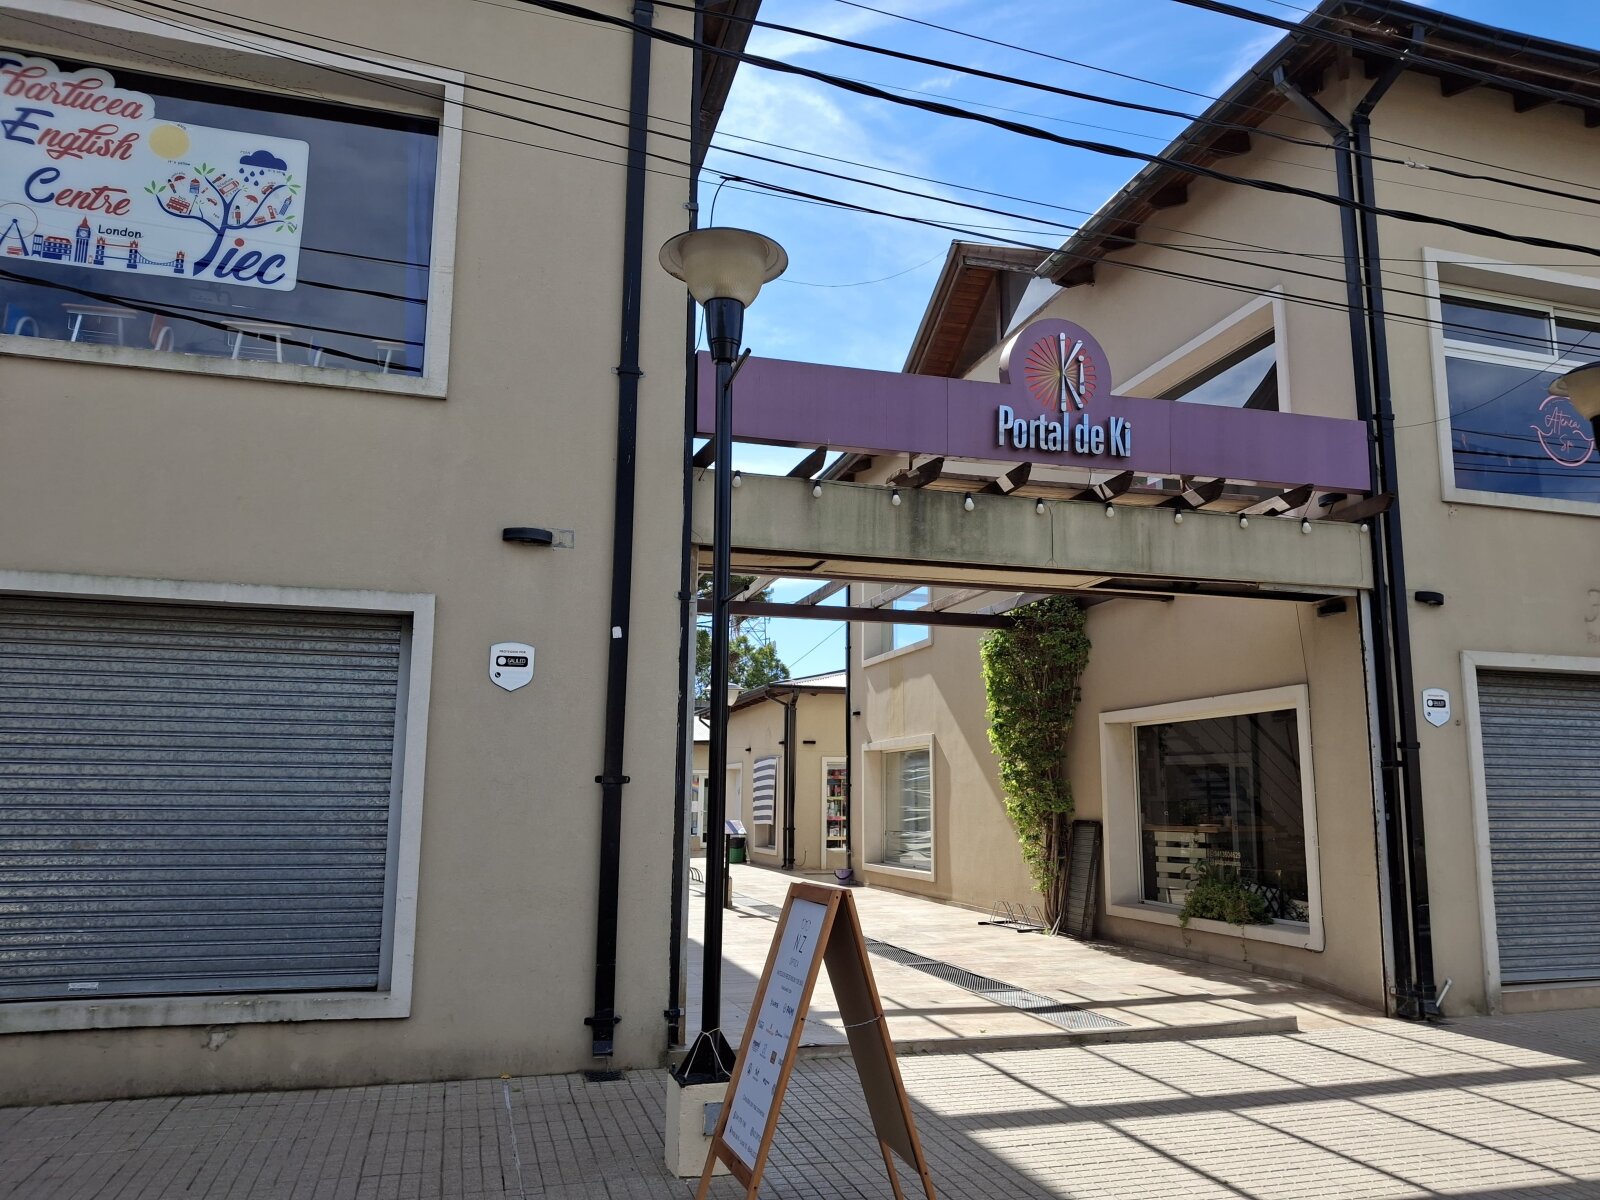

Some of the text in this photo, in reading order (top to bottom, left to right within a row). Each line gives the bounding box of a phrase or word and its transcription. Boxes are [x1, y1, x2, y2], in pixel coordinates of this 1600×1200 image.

[0, 58, 143, 119] barlucea
[1, 107, 140, 160] English
[24, 167, 131, 216] Centre
[98, 224, 142, 239] London
[998, 404, 1132, 457] Portal de Ki
